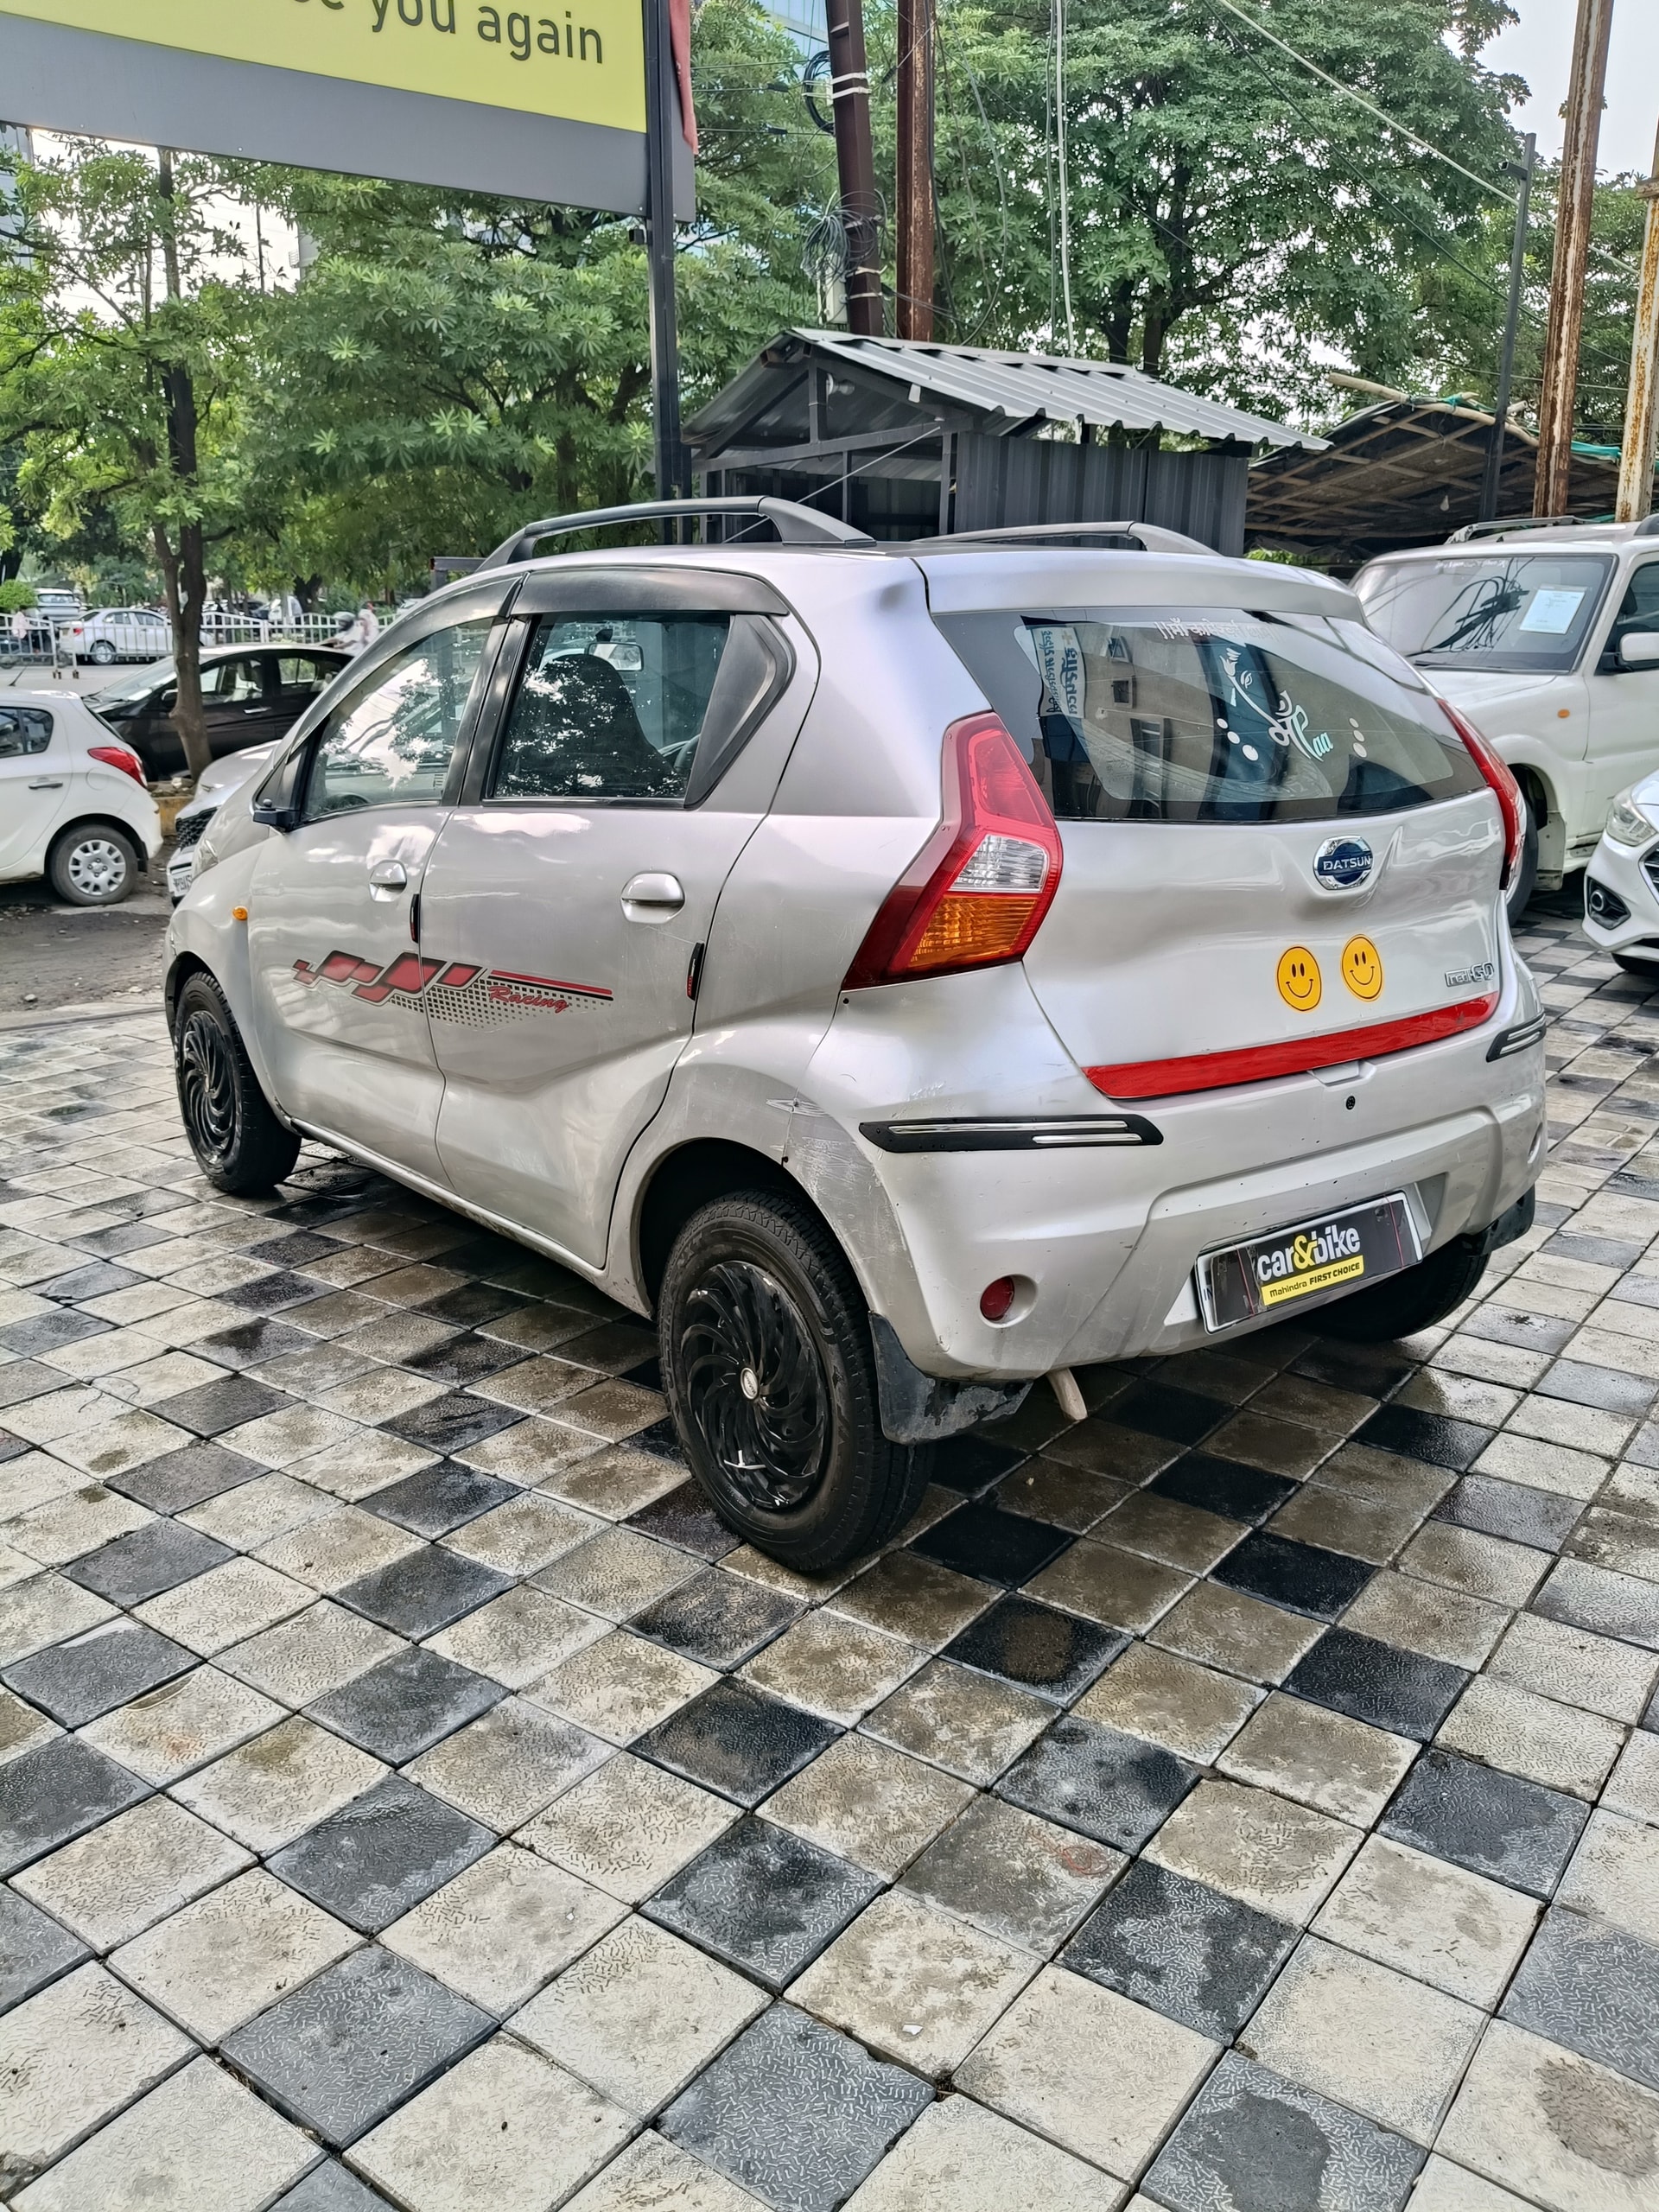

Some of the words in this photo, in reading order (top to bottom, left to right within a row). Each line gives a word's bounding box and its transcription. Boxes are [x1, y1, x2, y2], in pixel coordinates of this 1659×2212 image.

[372, 0, 456, 34] you
[477, 5, 603, 64] again
[1323, 855, 1371, 871] DATSUN
[488, 986, 568, 1014] Racing
[1257, 1224, 1361, 1281] car&bike
[1270, 1281, 1307, 1297] Mahindra
[1309, 1272, 1332, 1286] FIRST
[1332, 1262, 1361, 1277] CHOICE
